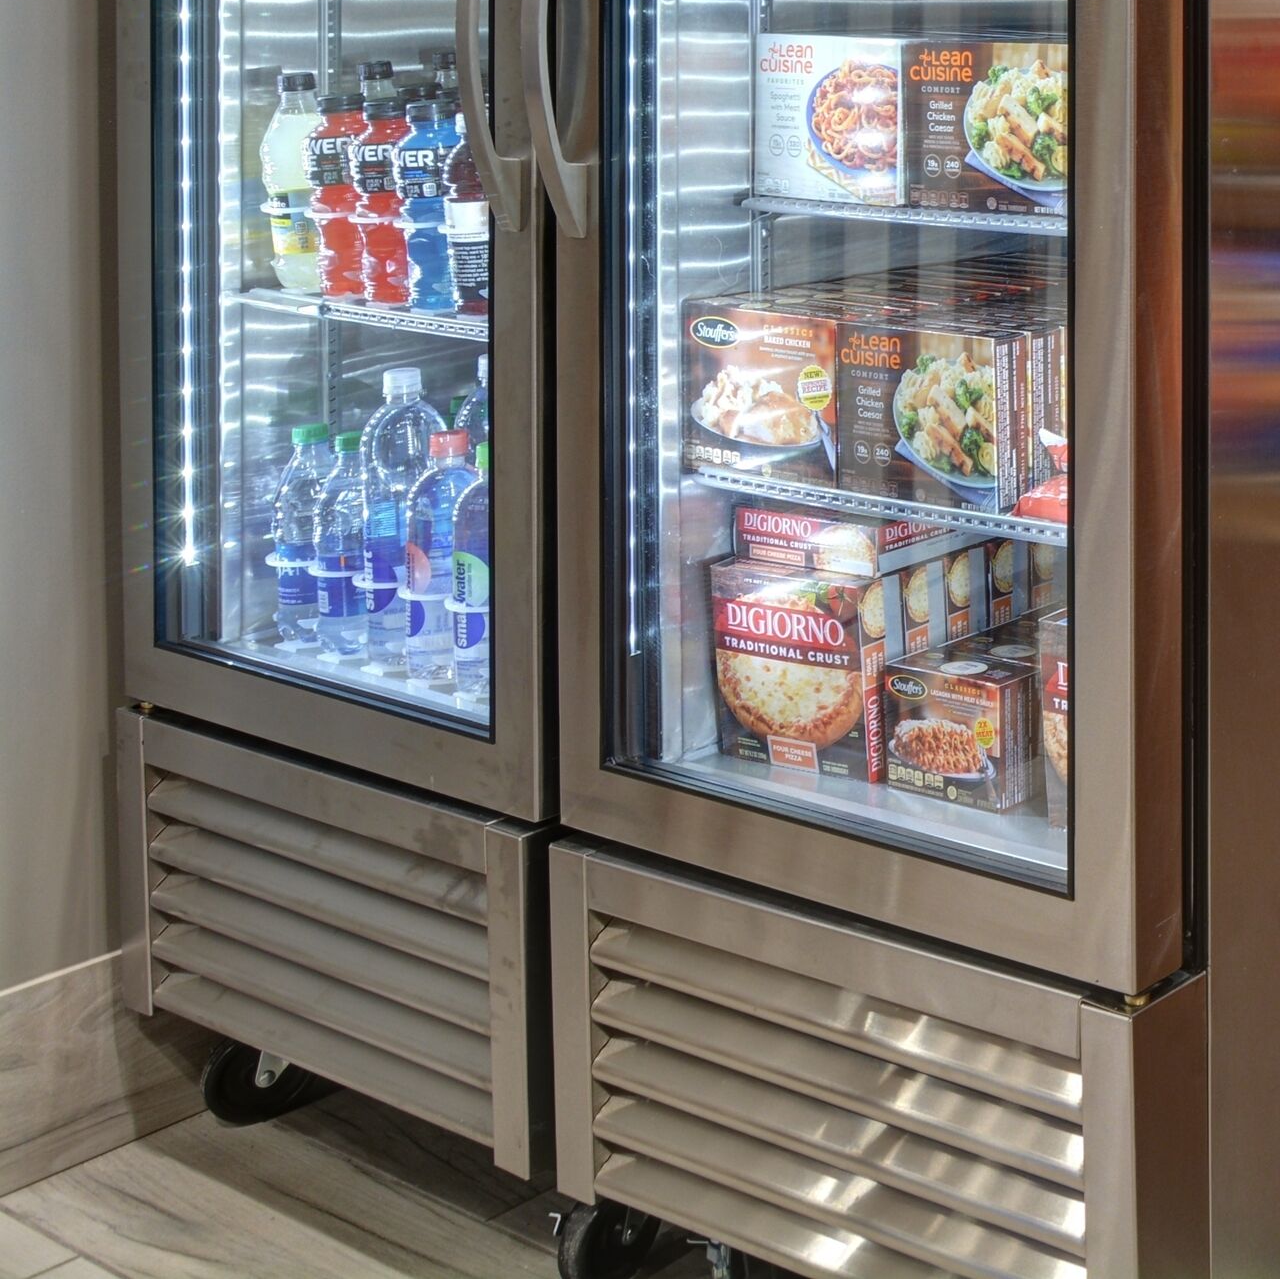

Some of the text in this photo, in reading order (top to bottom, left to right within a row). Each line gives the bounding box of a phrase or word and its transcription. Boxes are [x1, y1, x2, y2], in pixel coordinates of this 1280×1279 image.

[921, 86, 961, 94] COMFORT
[929, 101, 953, 110] Grilled
[927, 112, 955, 122] Chicken
[929, 123, 954, 133] Caesar
[851, 369, 889, 380] COMFORT
[858, 385, 881, 397] Grilled
[856, 397, 884, 410] Chicken
[858, 408, 883, 420] Caesar
[724, 636, 849, 666] TRADITIONAL CRUST
